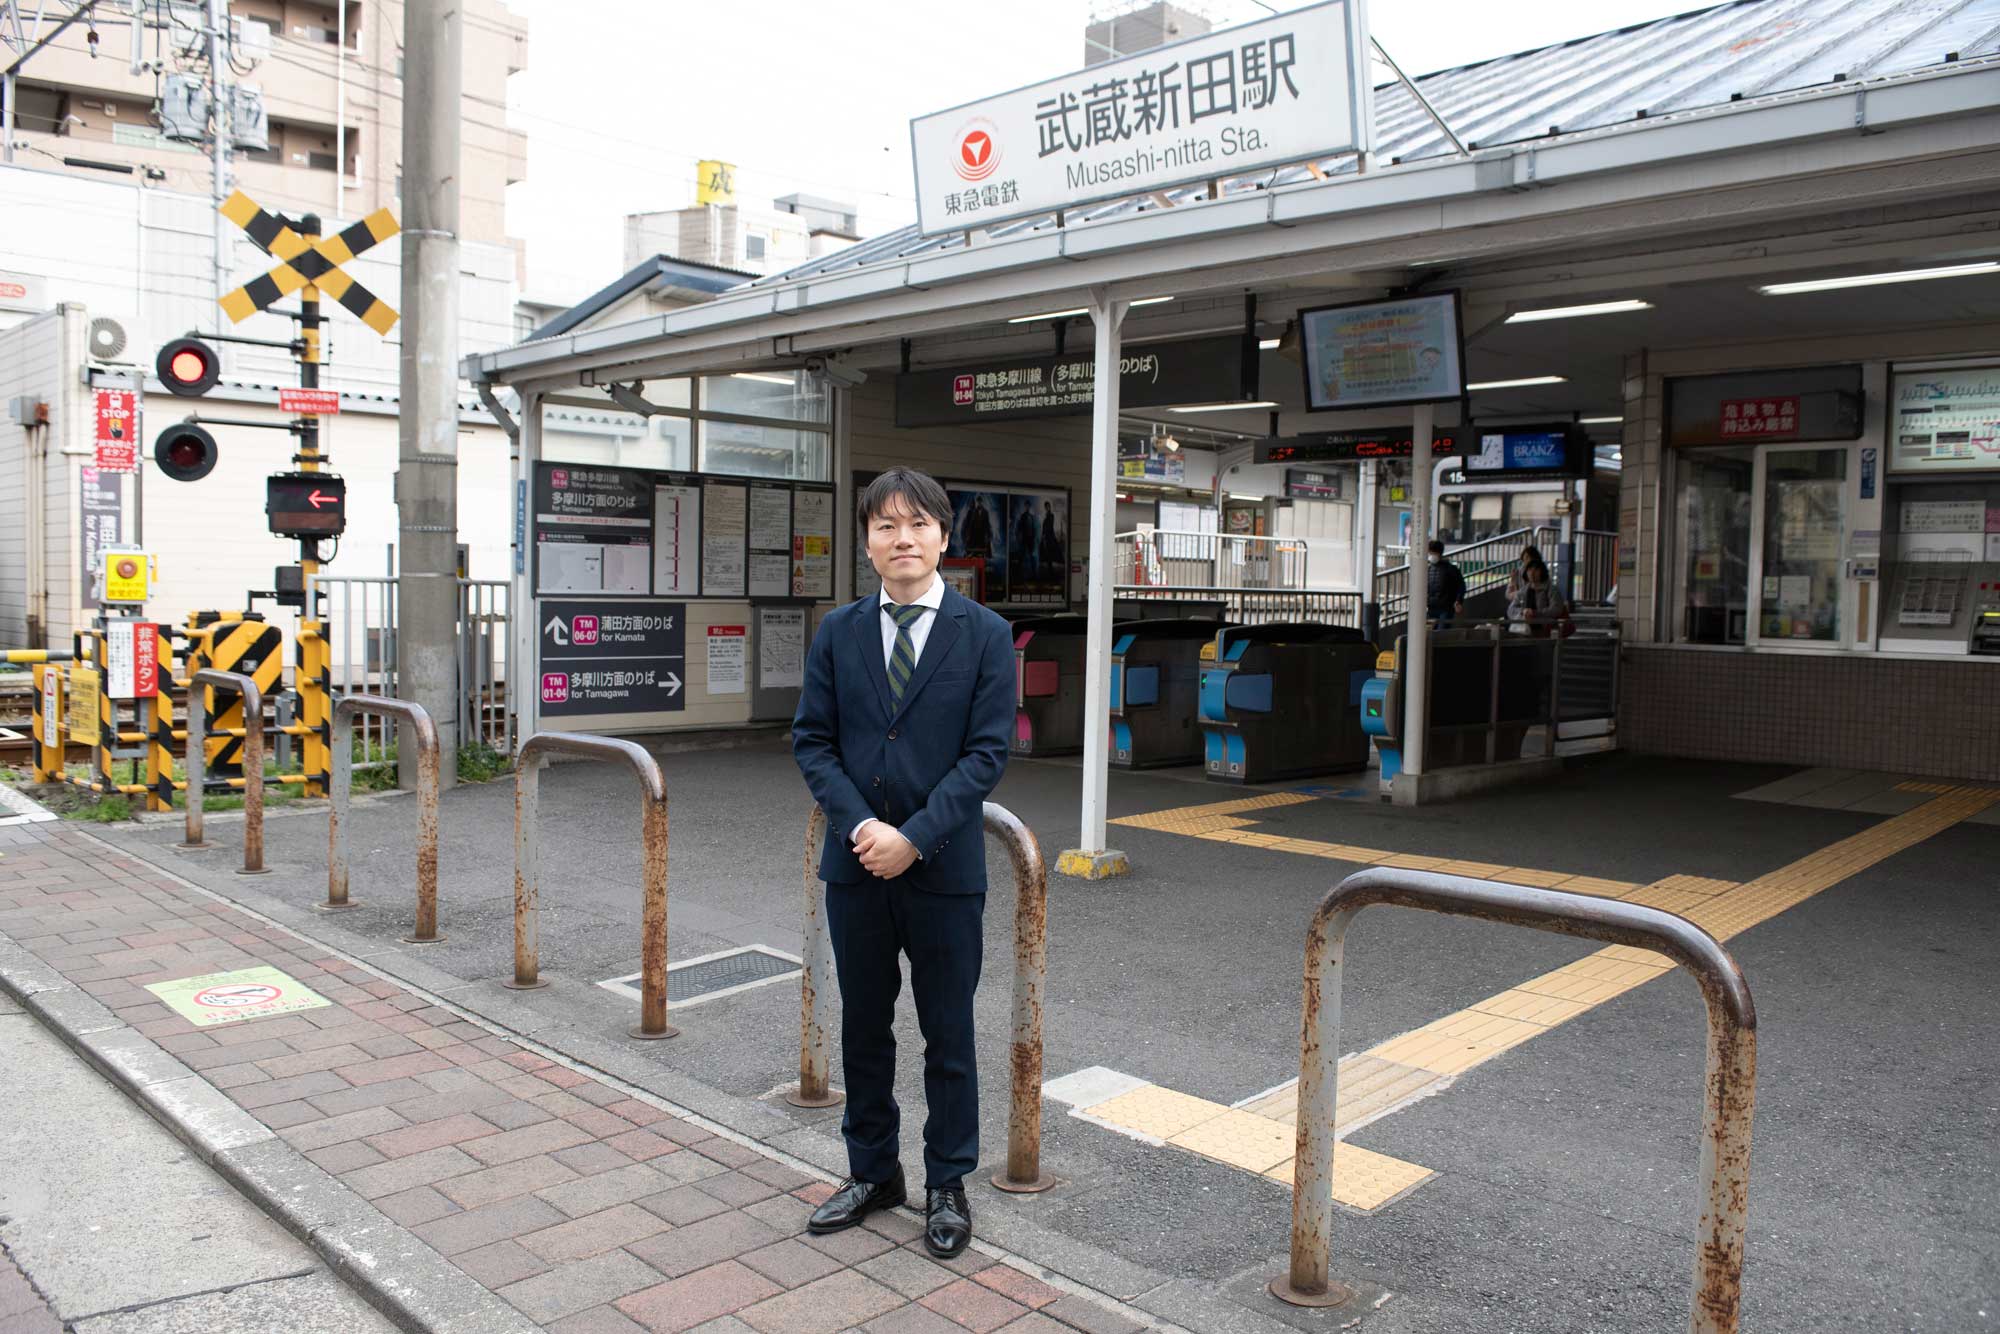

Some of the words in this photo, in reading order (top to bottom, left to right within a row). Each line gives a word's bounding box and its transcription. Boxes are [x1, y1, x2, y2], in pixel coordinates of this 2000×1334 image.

[1035, 32, 1299, 158] 武蔵新田駅
[1066, 136, 1212, 190] Musashi-nitta
[1221, 125, 1268, 155] Sta.
[944, 179, 1019, 215] 東急電鉄
[976, 368, 1042, 388] 東急多摩川線
[1050, 354, 1159, 393] (多摩川のりば)
[958, 379, 970, 388] TM
[1056, 383, 1067, 393] for
[955, 391, 973, 401] 01-04
[976, 390, 995, 401] Tokyu
[996, 388, 1031, 399] Tamagawa
[1032, 385, 1047, 395] Line
[101, 408, 130, 419] STOP
[1725, 401, 1794, 418] 危険物品
[571, 471, 620, 483] 東急多摩川線
[552, 491, 636, 509] 多摩川方面のりば
[562, 506, 593, 514] Tamagawa
[579, 619, 593, 628] TM
[601, 615, 674, 631] 蒲田方面のりば
[574, 630, 597, 641] 06-07
[601, 633, 613, 641] for
[614, 633, 646, 642] Kamata
[137, 626, 154, 693] 非常ボタン
[548, 677, 562, 686] TM
[571, 671, 656, 688] 多摩川方面のりば
[543, 688, 567, 698] 01-04
[571, 690, 583, 699] for
[585, 689, 629, 699] Tamagawa
